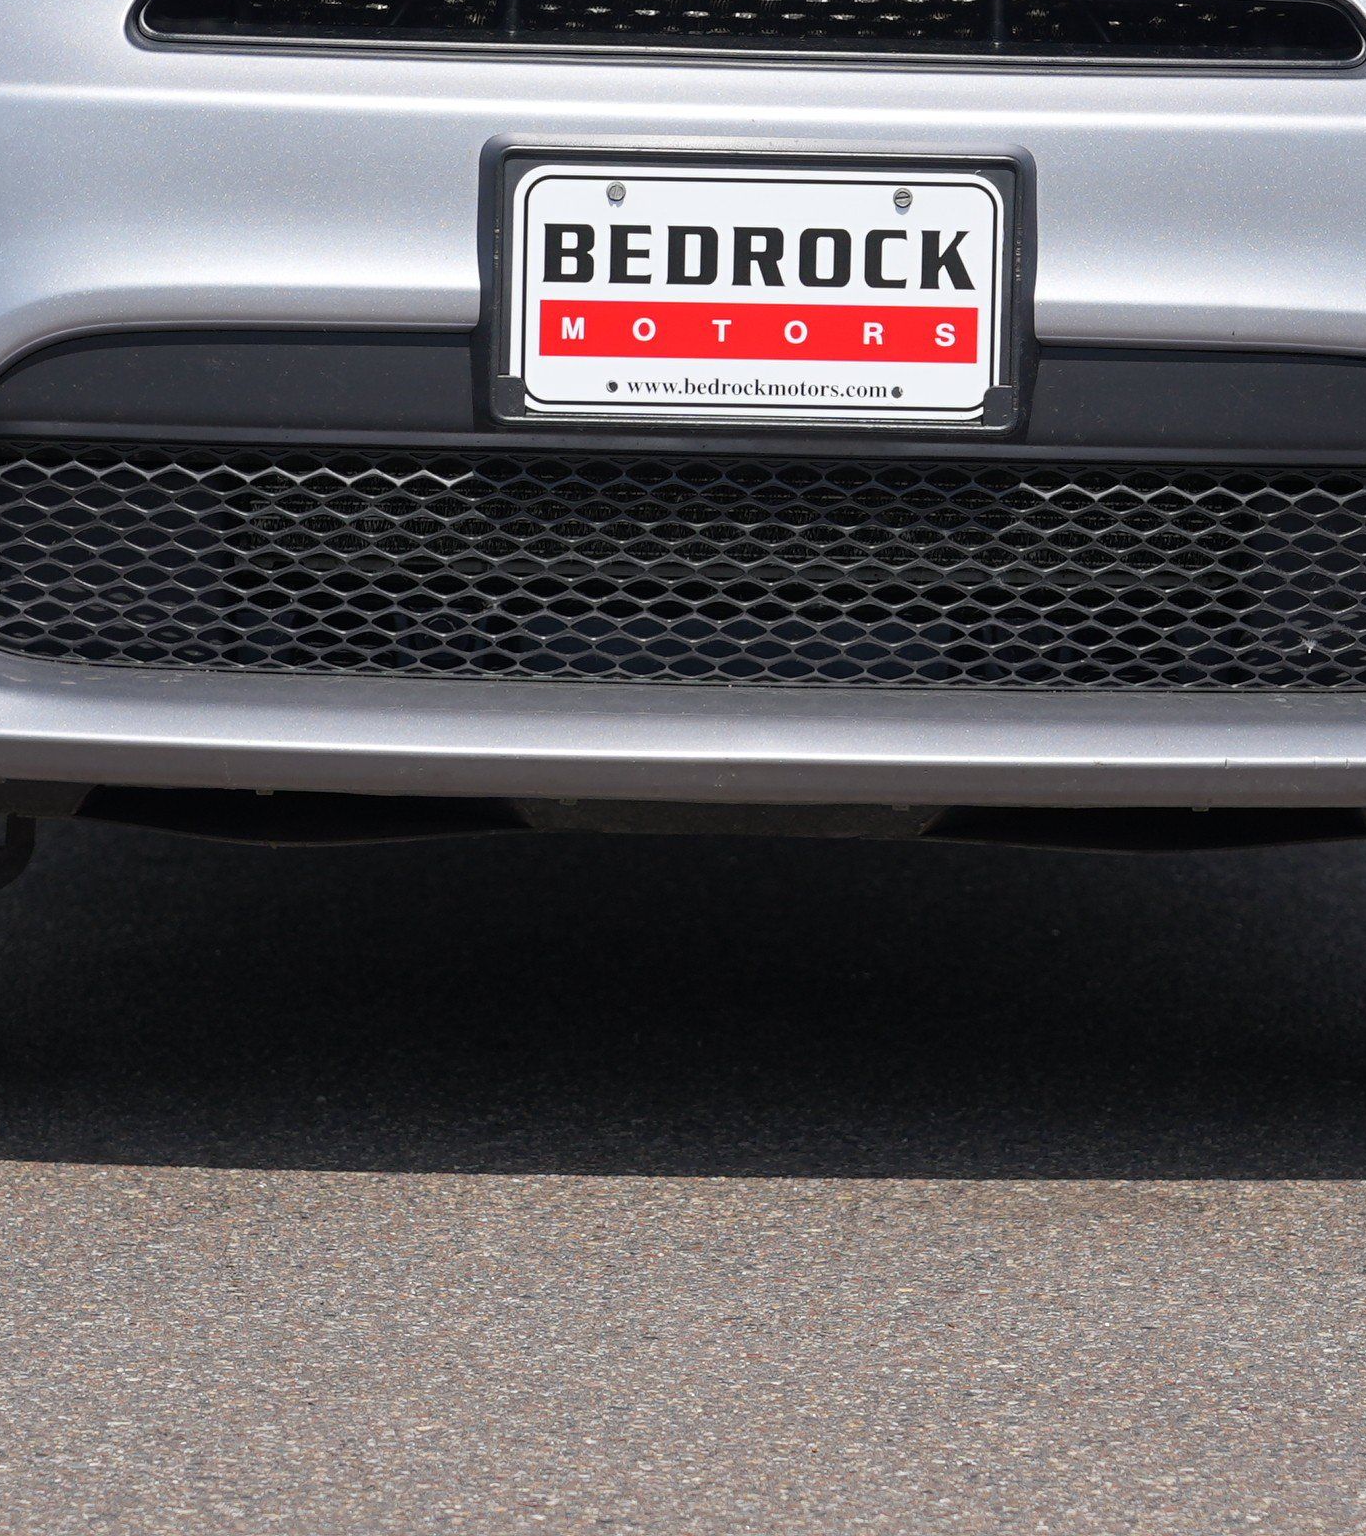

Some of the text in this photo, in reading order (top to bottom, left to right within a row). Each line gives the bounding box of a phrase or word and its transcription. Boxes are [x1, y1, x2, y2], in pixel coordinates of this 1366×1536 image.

[542, 223, 976, 290] BEDROCK
[561, 317, 956, 348] MOTORS
[626, 377, 887, 399] www.bedrockmotors.com
